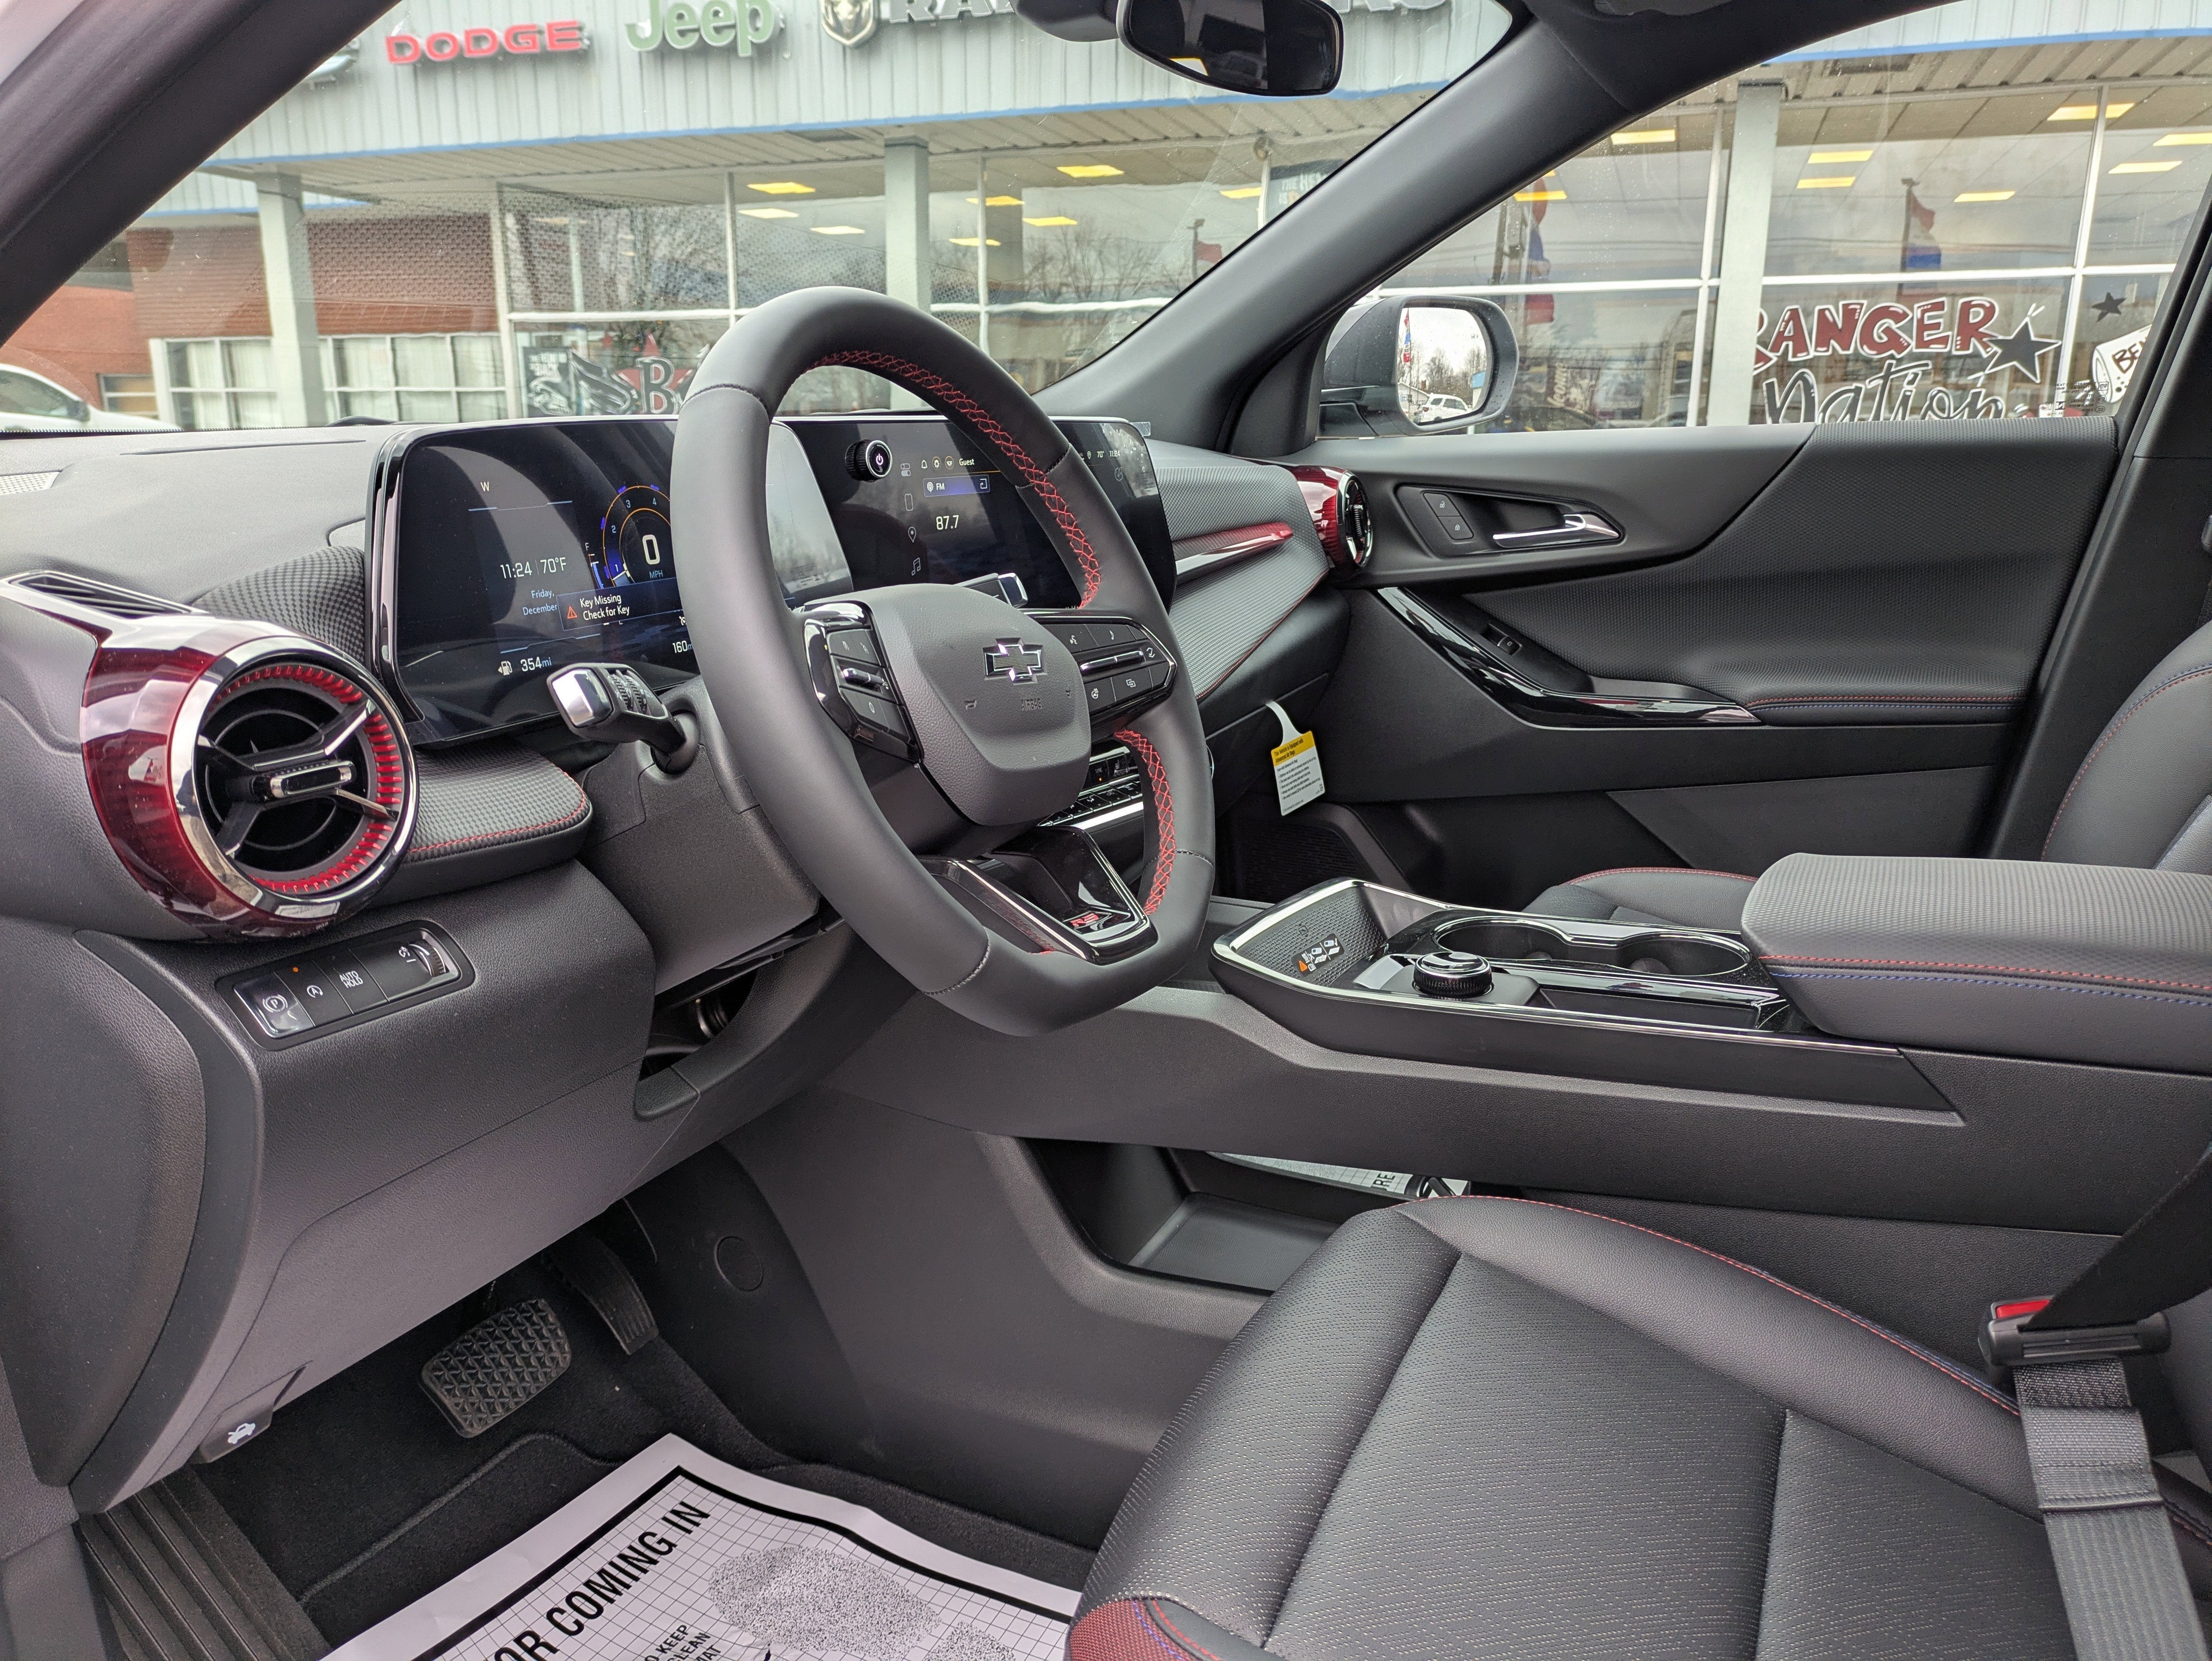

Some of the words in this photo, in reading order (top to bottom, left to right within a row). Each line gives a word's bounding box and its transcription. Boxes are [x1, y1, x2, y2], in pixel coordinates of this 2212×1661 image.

[625, 0, 775, 57] Jeep
[385, 20, 582, 64] DODGE
[2111, 340, 2145, 374] BE
[480, 481, 489, 492] W
[936, 483, 945, 491] FM
[626, 499, 631, 508] 3
[653, 498, 657, 506] 4
[611, 525, 617, 533] 2
[936, 515, 959, 531] 87.7
[585, 543, 589, 551] F
[642, 534, 661, 565] 0
[500, 562, 532, 579] 11:24
[540, 557, 567, 574] 70°F
[615, 564, 619, 572] 1
[649, 569, 664, 579] MPH
[531, 589, 555, 599] Friday,
[579, 598, 593, 608] Key
[594, 594, 622, 605] Missing
[522, 603, 558, 616] December
[583, 609, 606, 621] Check
[605, 607, 616, 617] for
[617, 605, 630, 616] Key
[1021, 698, 1042, 711] AIRBAG
[339, 971, 359, 982] AUTO
[343, 977, 364, 988] HOLD
[493, 1630, 559, 1661] OR
[546, 1531, 678, 1636] COMING
[661, 1501, 711, 1534] IN
[655, 1625, 689, 1654] KEEP
